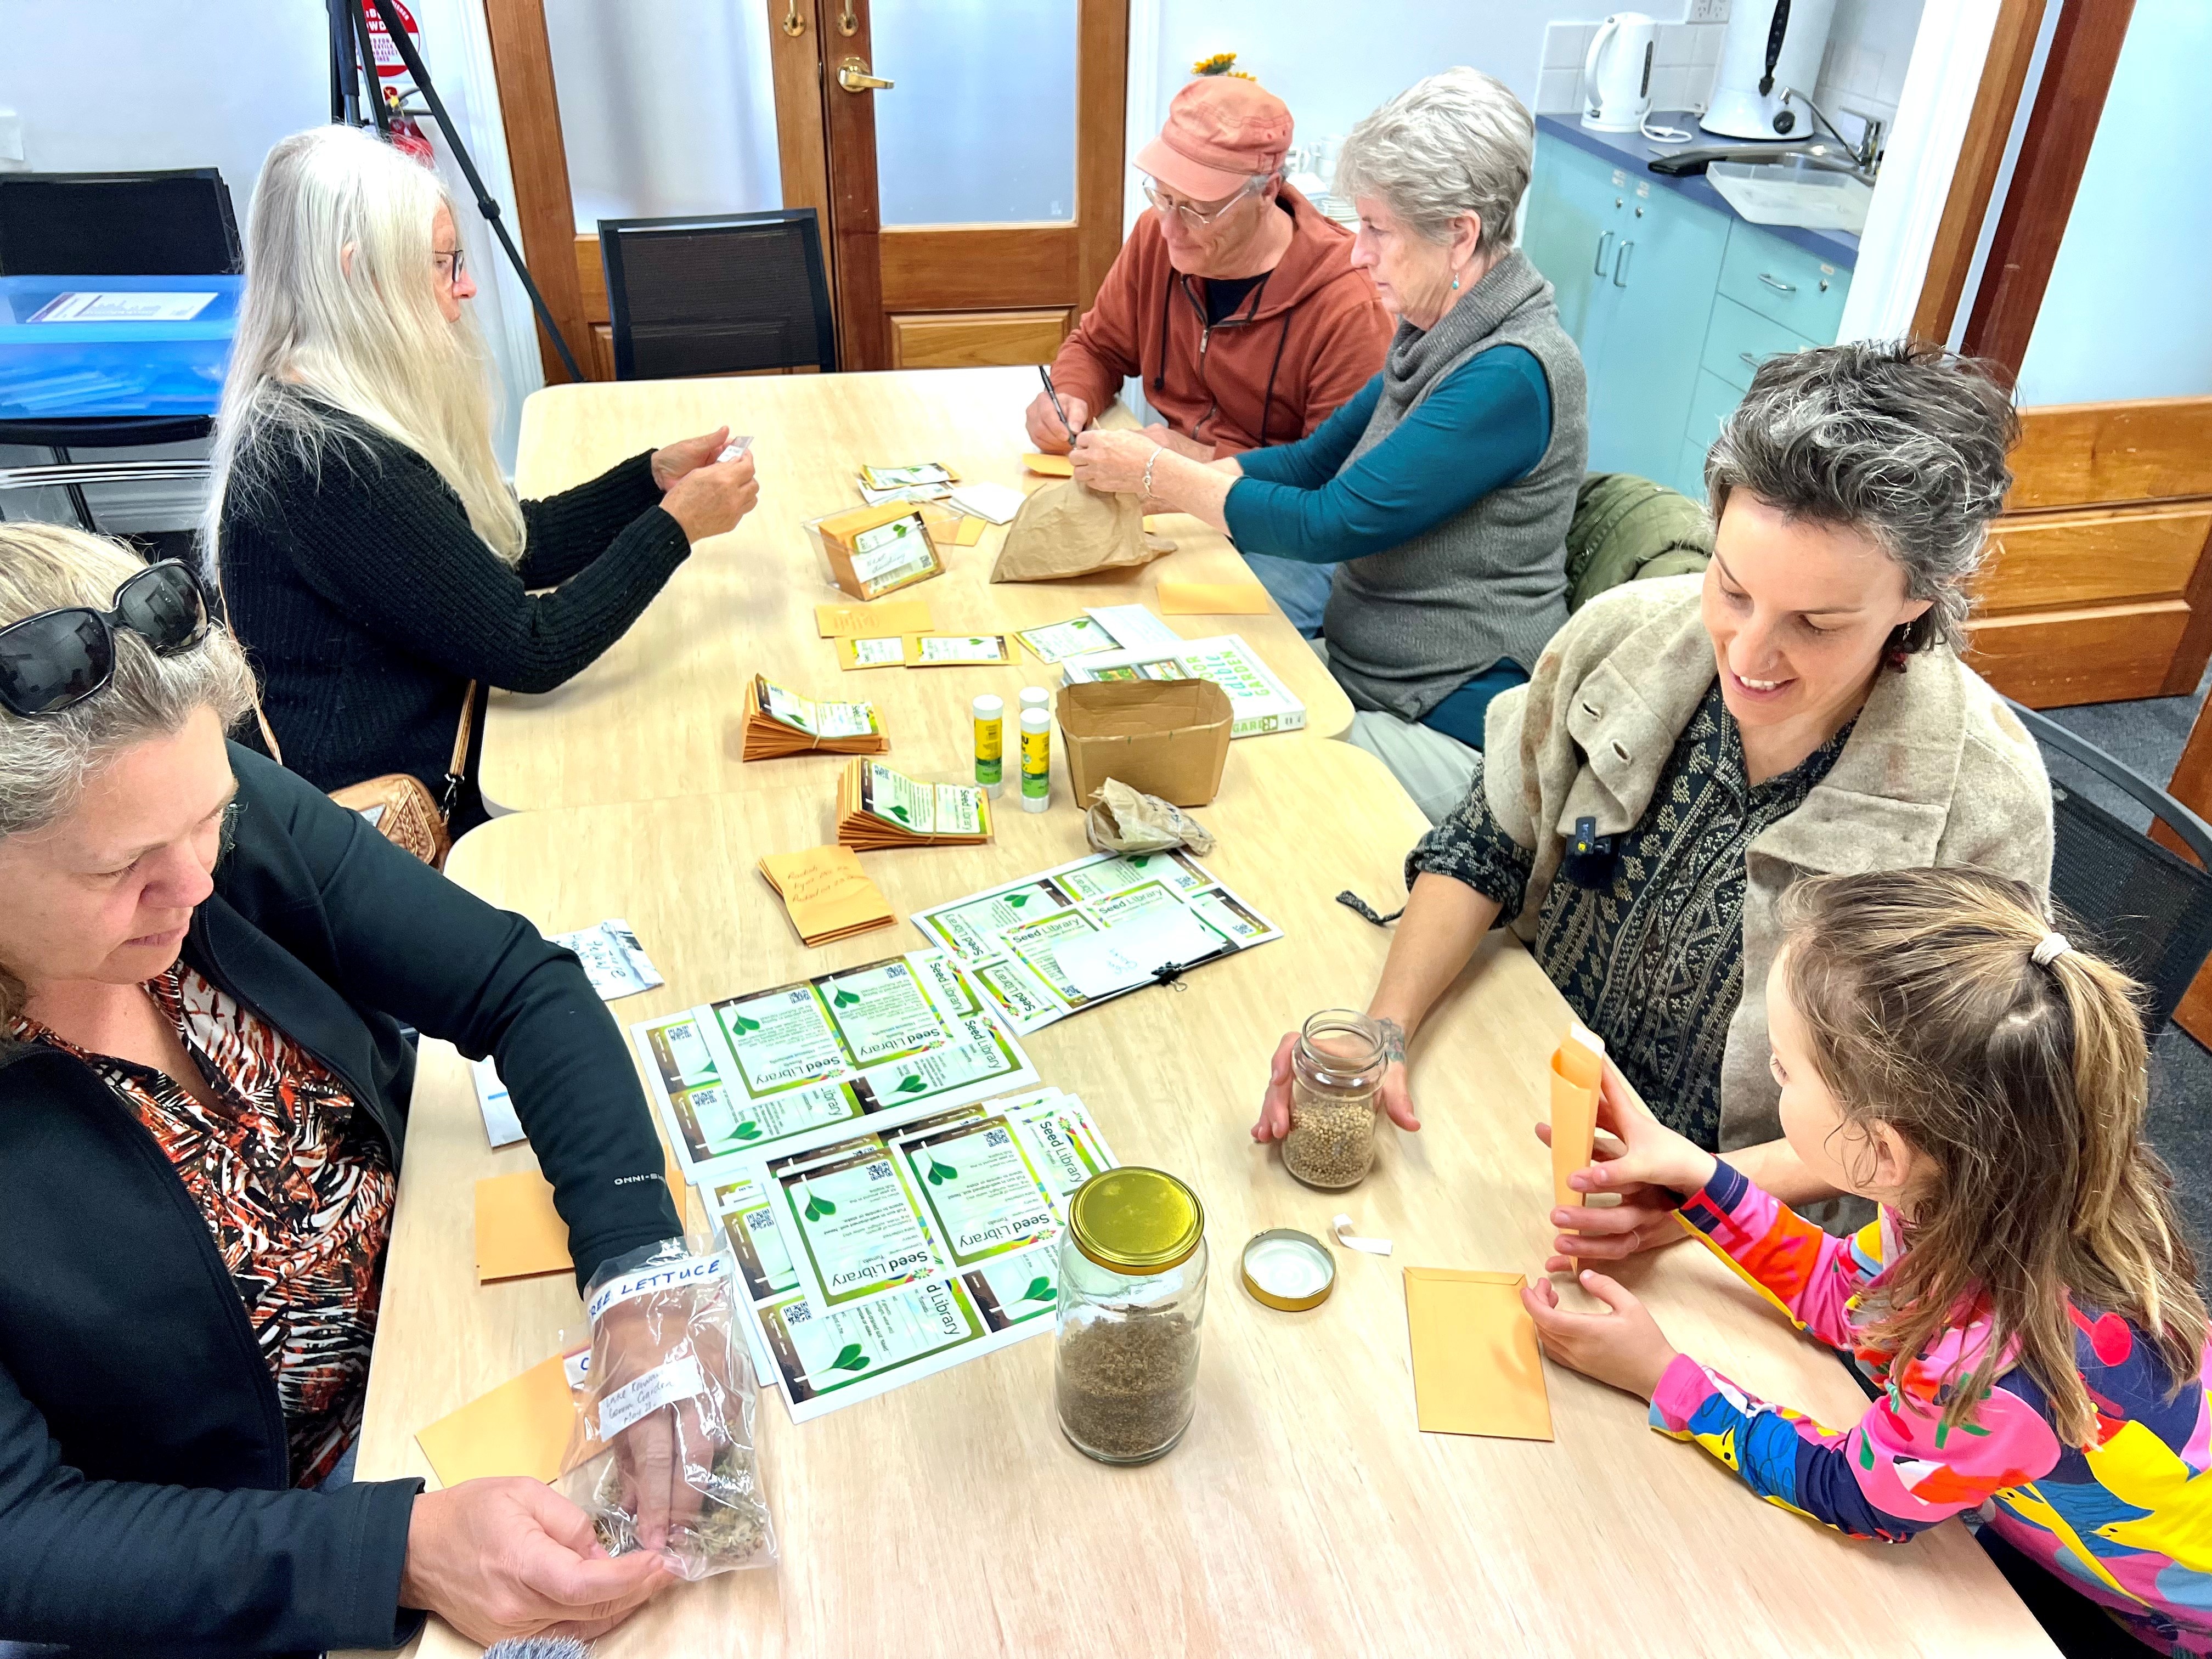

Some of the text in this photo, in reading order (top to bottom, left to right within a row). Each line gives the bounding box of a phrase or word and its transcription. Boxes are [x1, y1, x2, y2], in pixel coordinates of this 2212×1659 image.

[1205, 655, 1254, 697] edible
[1220, 650, 1272, 697] GARDEN
[1099, 900, 1126, 914] Seed
[1126, 889, 1163, 905] Library
[944, 913, 966, 937] Library
[1013, 929, 1042, 943] Seed
[1041, 918, 1079, 934] Library
[962, 937, 984, 956] Seed
[930, 963, 964, 1010] Seed Library
[991, 969, 1019, 994] Library
[1012, 992, 1036, 1011] Seed
[861, 1029, 940, 1056] Seed Library
[964, 1020, 984, 1040] Seed
[977, 1036, 1002, 1068] Library
[757, 1057, 840, 1084] Seed Library
[1040, 1121, 1084, 1182] Seed Library
[960, 1214, 1049, 1248] Seed Library
[833, 1251, 928, 1286] Seed Library
[589, 1259, 720, 1318] REE LETTUCE
[931, 1293, 960, 1334] Library
